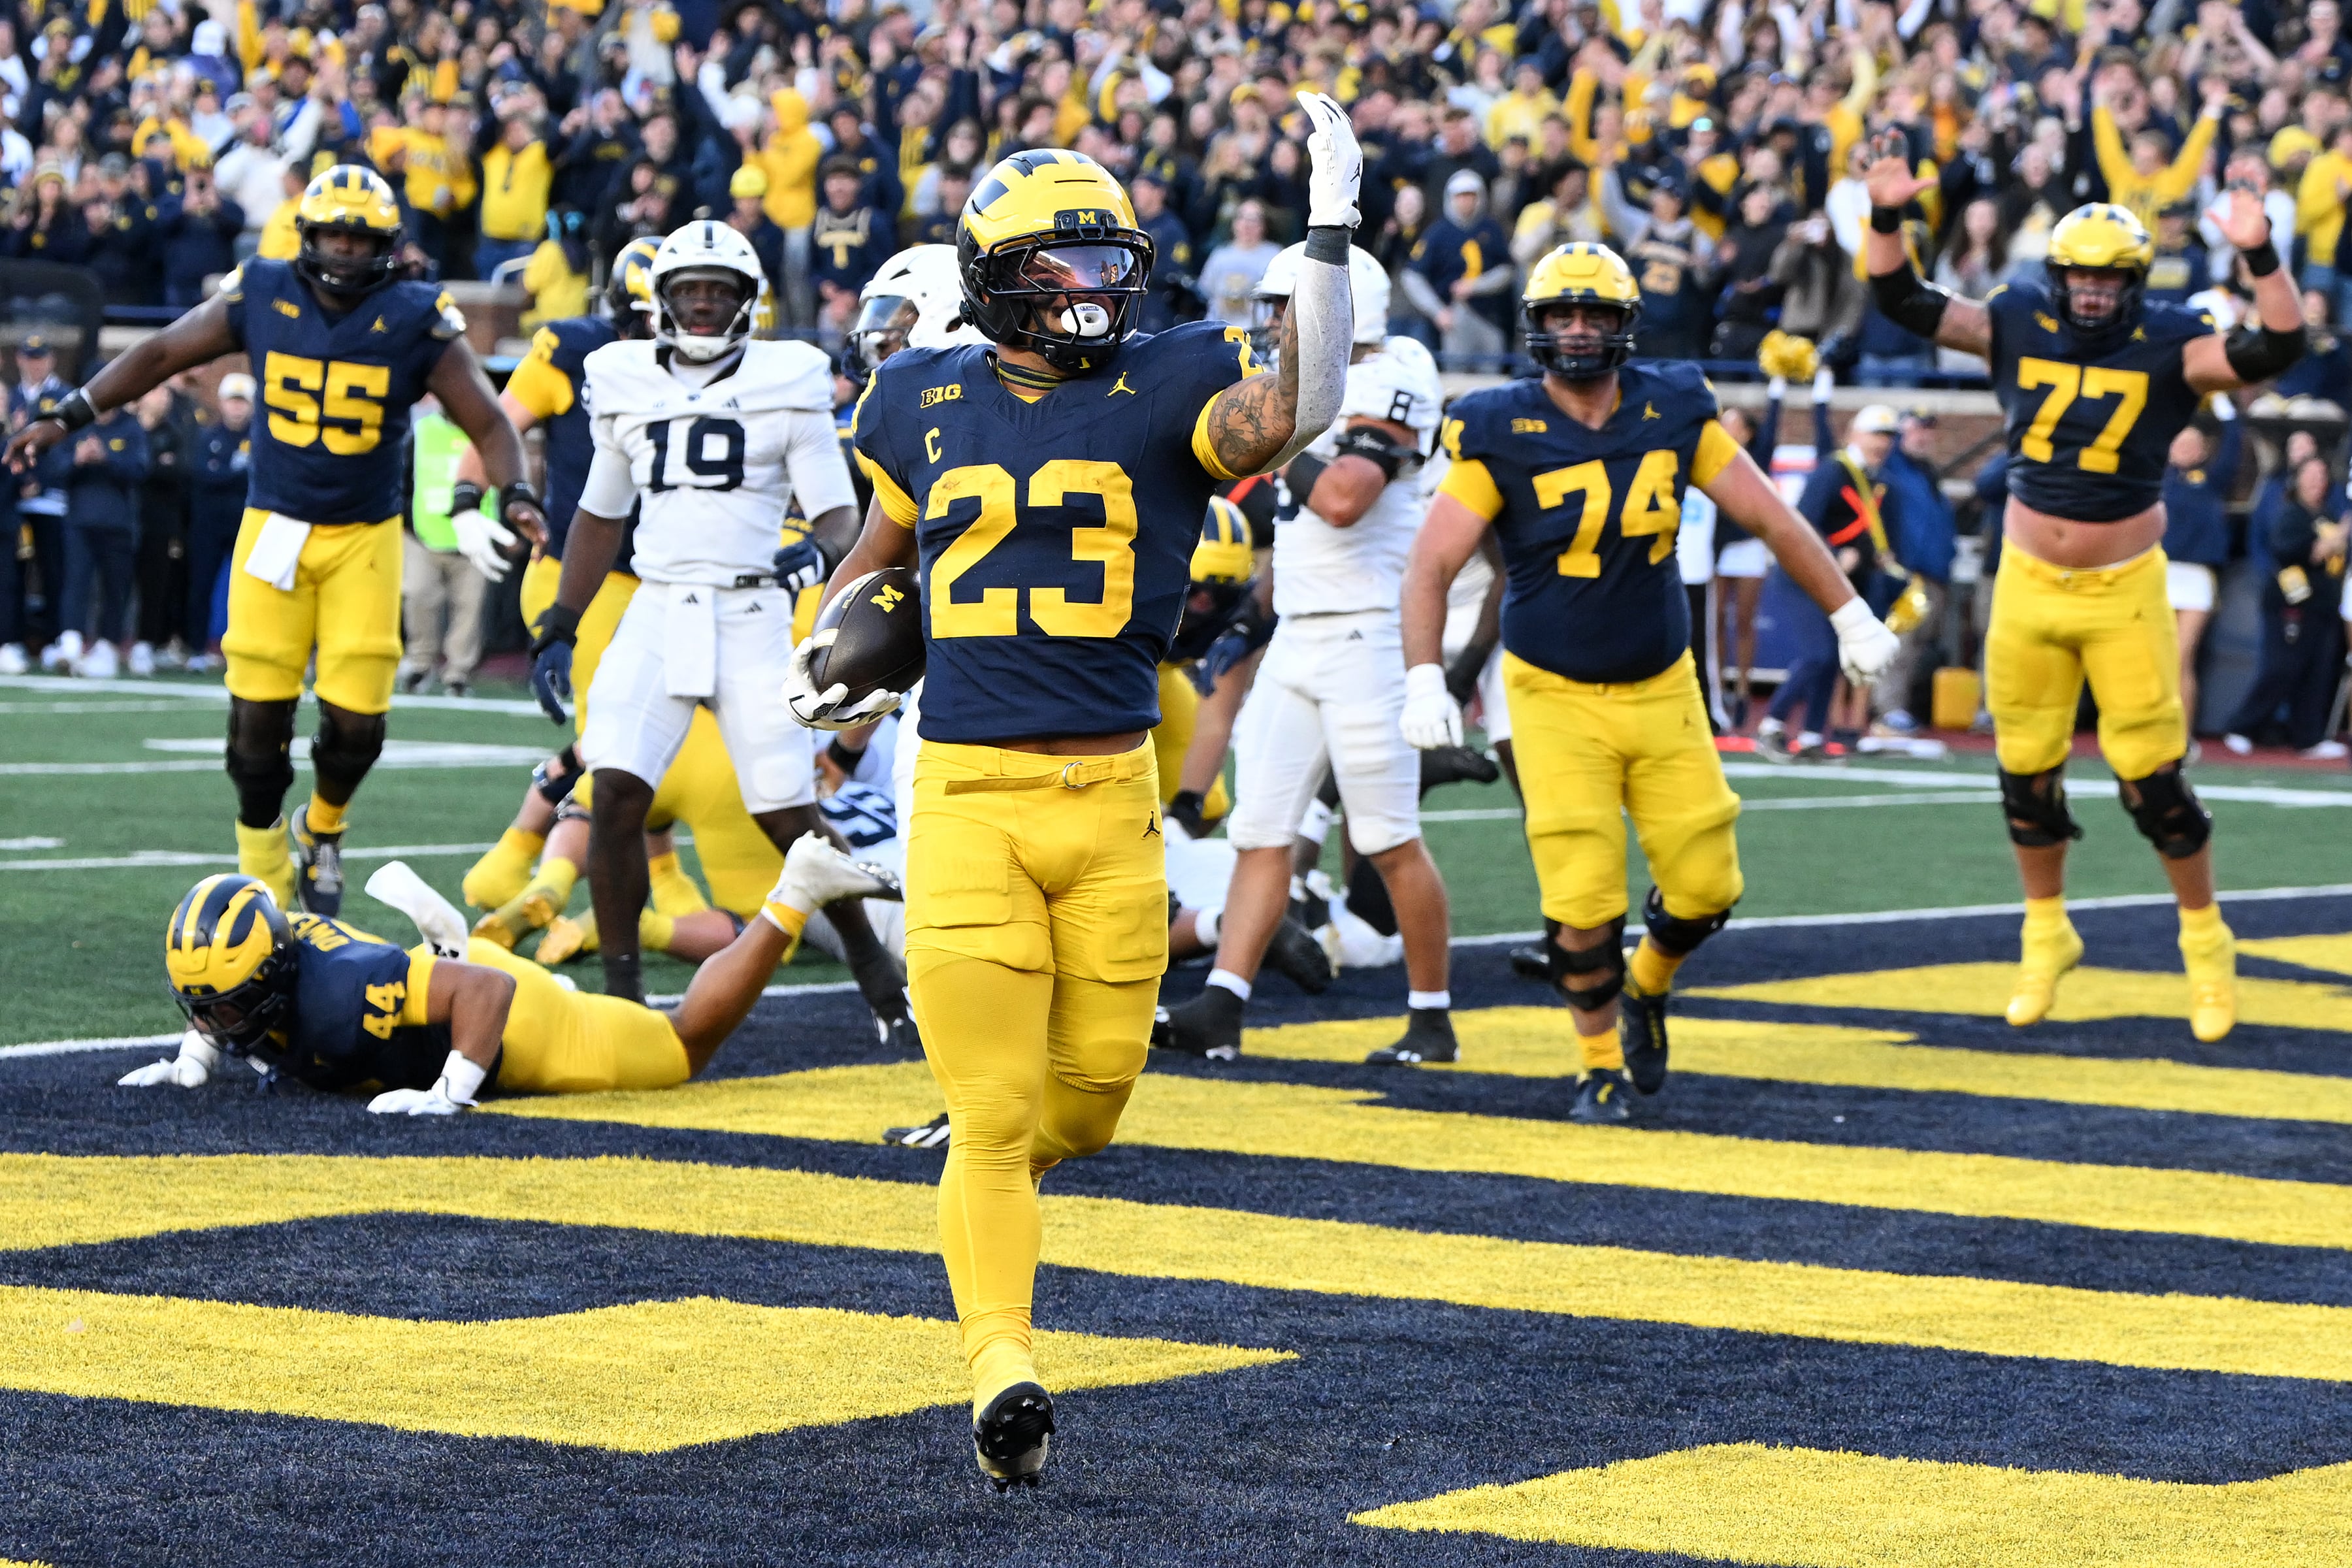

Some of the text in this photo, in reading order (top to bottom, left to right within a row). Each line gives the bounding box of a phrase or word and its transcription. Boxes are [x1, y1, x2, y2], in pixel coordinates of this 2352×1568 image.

[1077, 211, 1097, 224] M
[264, 350, 390, 455] 55
[1388, 390, 1414, 423] 8
[2017, 356, 2149, 474] 77
[646, 416, 745, 494] 19
[924, 427, 942, 465] C
[1531, 449, 1682, 579] 74
[924, 459, 1138, 639] 23
[870, 583, 905, 613] M
[363, 981, 405, 1040] 44
